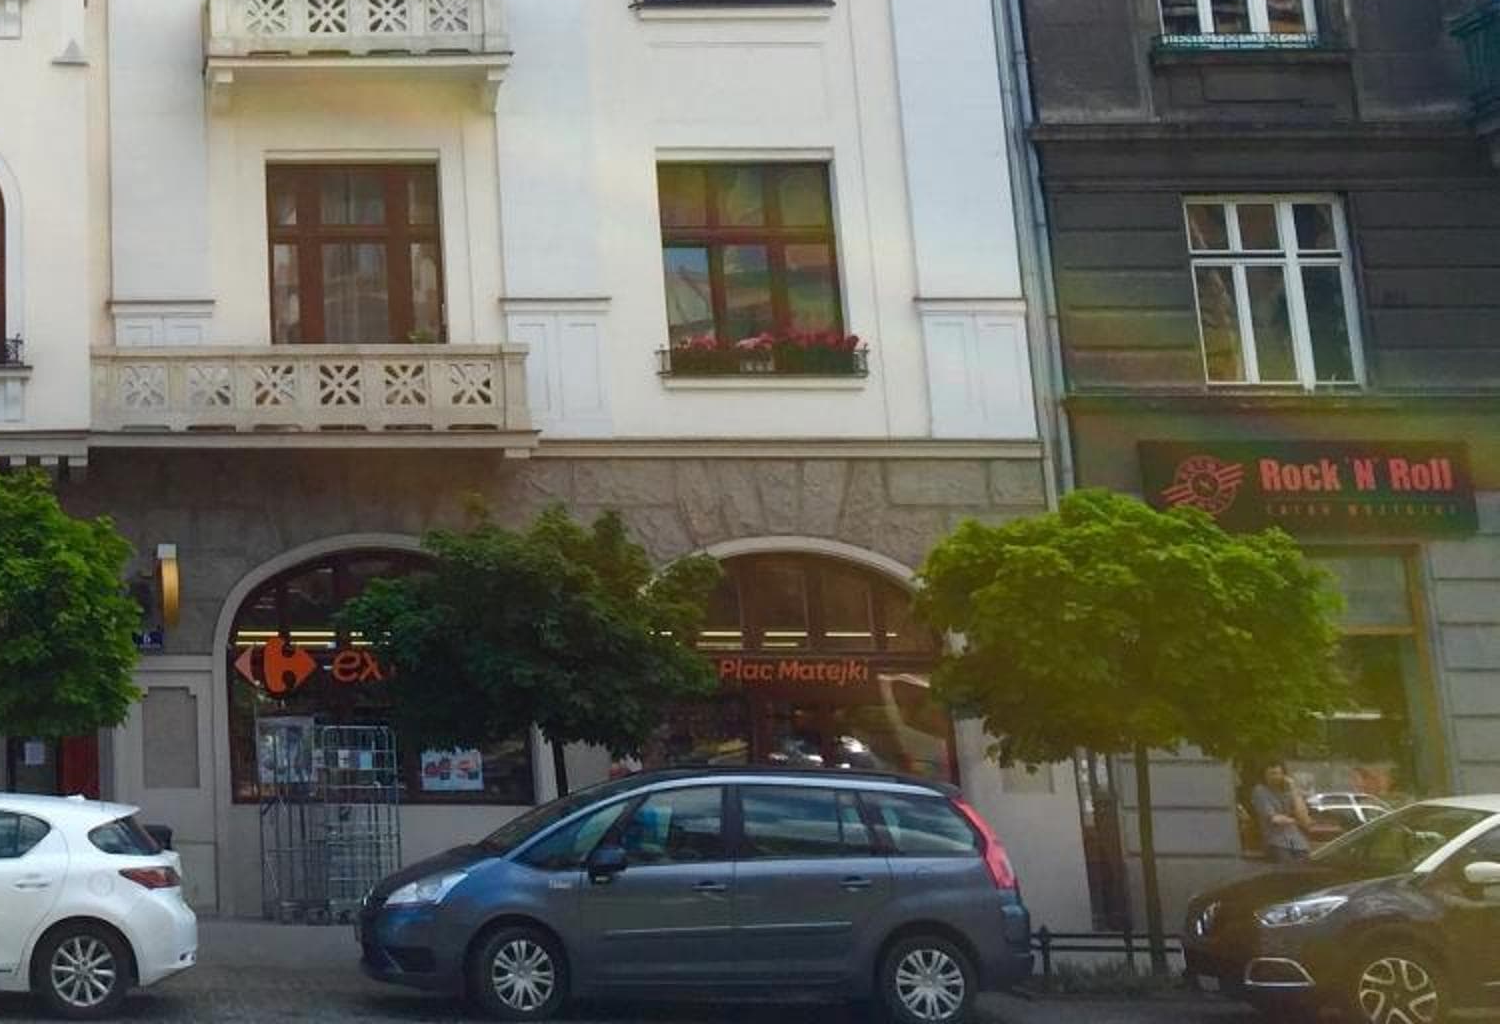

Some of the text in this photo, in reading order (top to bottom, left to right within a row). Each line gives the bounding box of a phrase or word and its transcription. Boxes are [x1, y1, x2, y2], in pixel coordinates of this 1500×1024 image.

[1258, 458, 1341, 491] Rock
[1388, 457, 1452, 491] Roll
[721, 658, 869, 687] Plac Matejki
